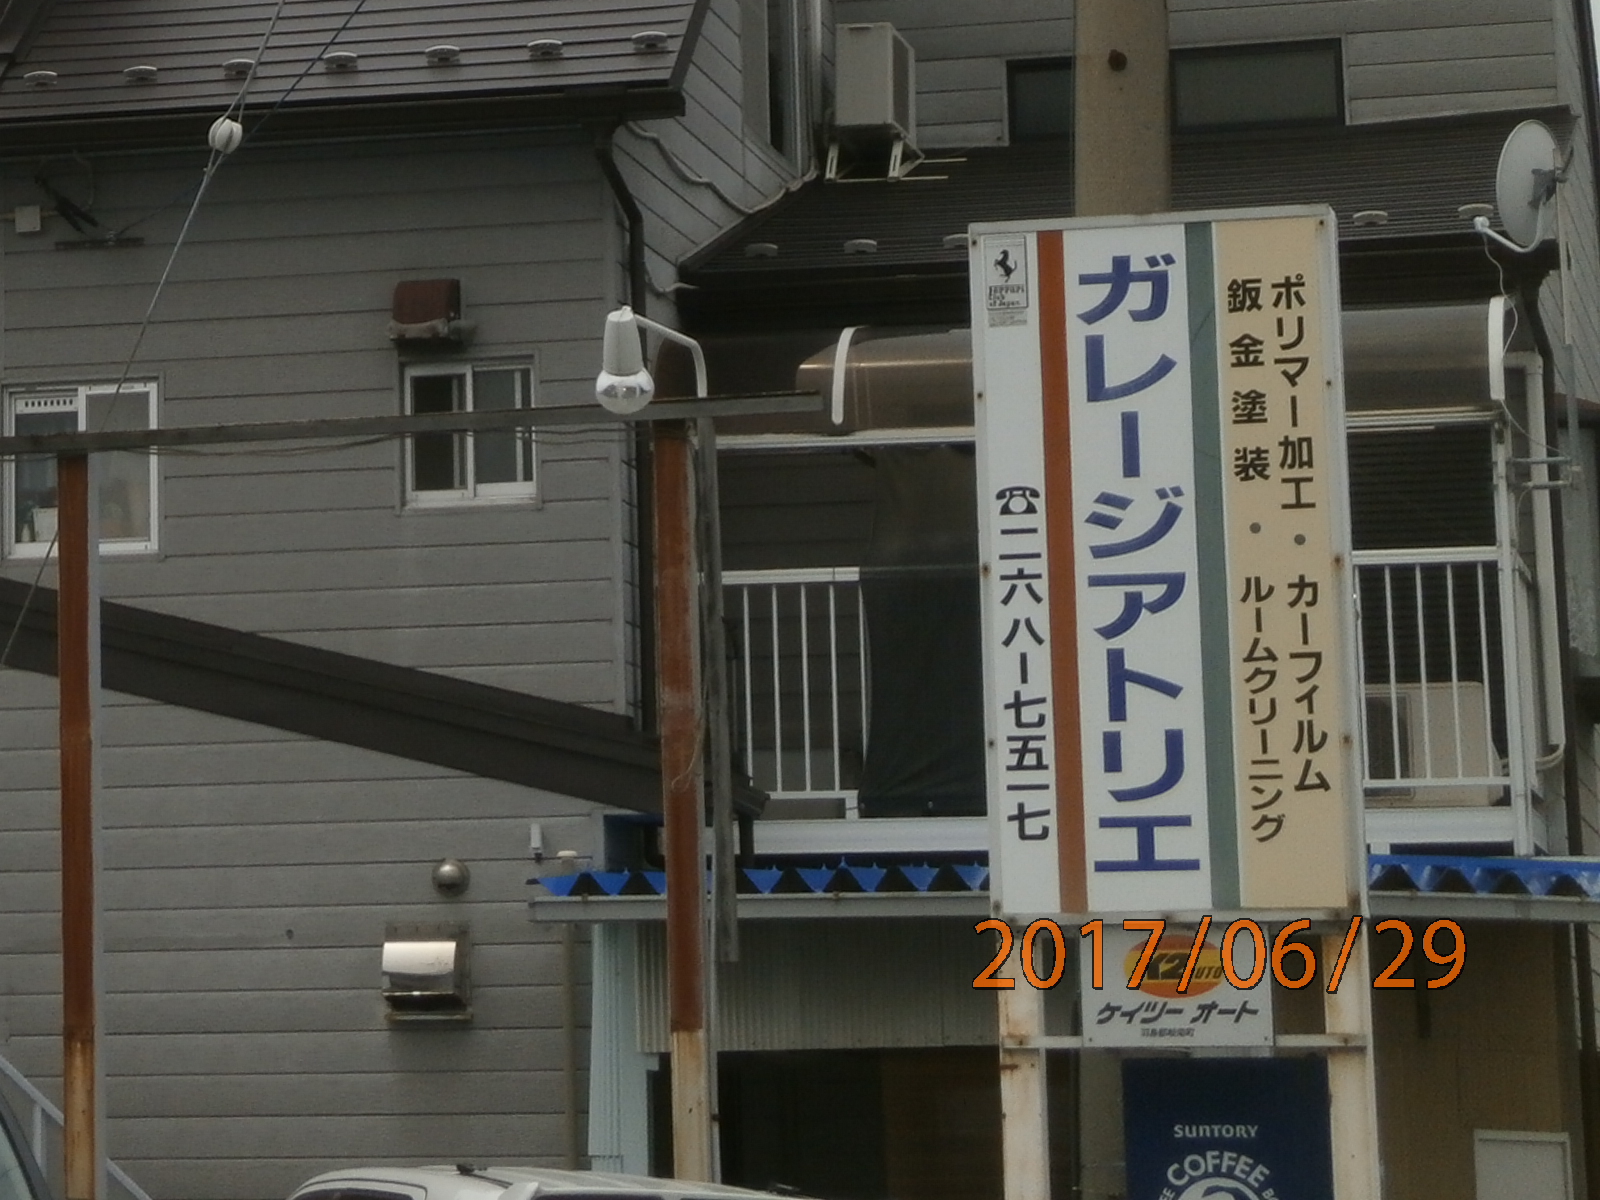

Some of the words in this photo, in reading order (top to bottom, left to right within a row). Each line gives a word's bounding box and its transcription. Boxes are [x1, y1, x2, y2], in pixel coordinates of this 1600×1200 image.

[1076, 253, 1199, 871] ガレージアトリエ
[1096, 1001, 1184, 1024] ケイツー
[1189, 1000, 1259, 1024] オート
[1166, 1150, 1270, 1188] COFFEE
